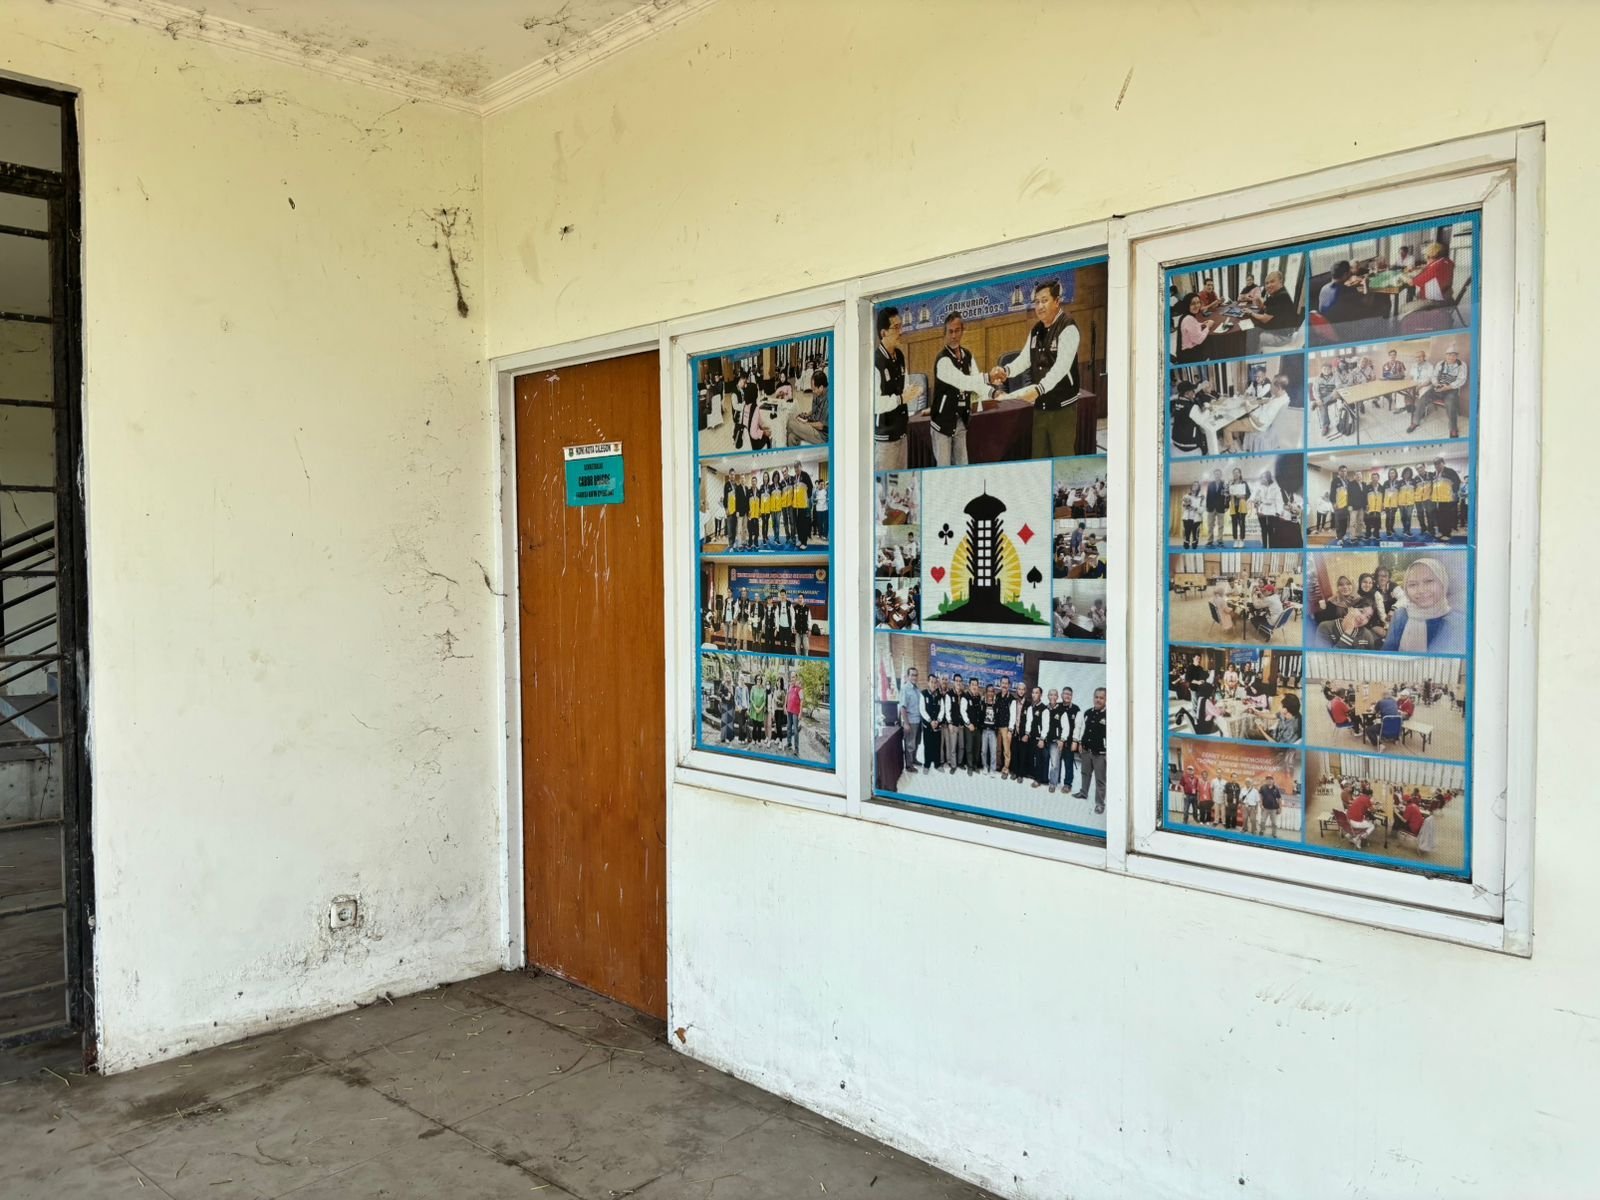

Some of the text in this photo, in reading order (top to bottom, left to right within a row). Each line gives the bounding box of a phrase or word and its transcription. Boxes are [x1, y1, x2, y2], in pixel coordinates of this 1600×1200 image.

[945, 296, 989, 313] SARIKURING
[586, 446, 595, 454] KOTA
[596, 444, 611, 454] CILEGON
